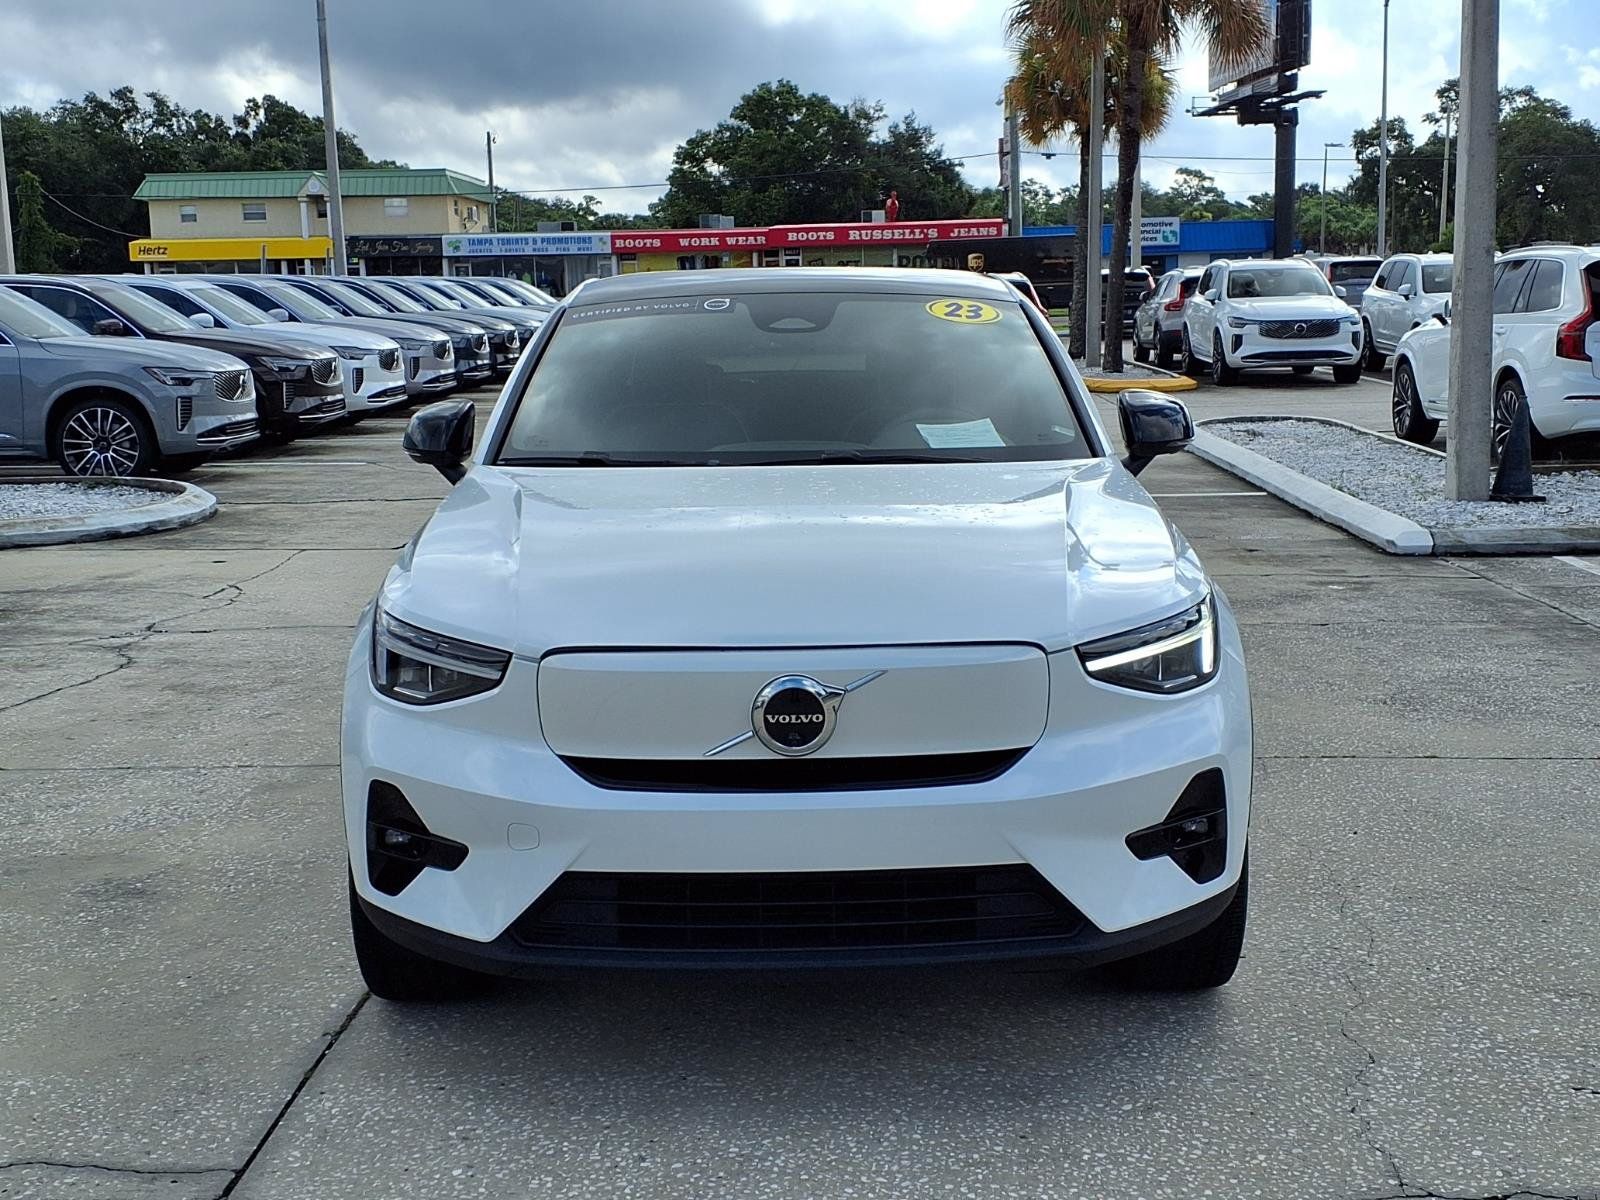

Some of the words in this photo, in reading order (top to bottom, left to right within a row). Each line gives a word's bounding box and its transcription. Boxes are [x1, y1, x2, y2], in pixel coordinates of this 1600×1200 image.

[787, 231, 835, 241] BOOTS
[848, 228, 938, 240] RUSSELL'S
[950, 227, 998, 237] JEANS
[467, 238, 494, 246] TAMPA
[541, 236, 593, 245] PROMOTIONS
[615, 239, 661, 247] BOOTS
[678, 237, 720, 246] WORK
[725, 236, 766, 245] WEAR
[138, 246, 168, 255] Hertz
[572, 307, 631, 318] CERTIFIED
[944, 302, 983, 319] 23
[765, 714, 823, 723] VOLVO
